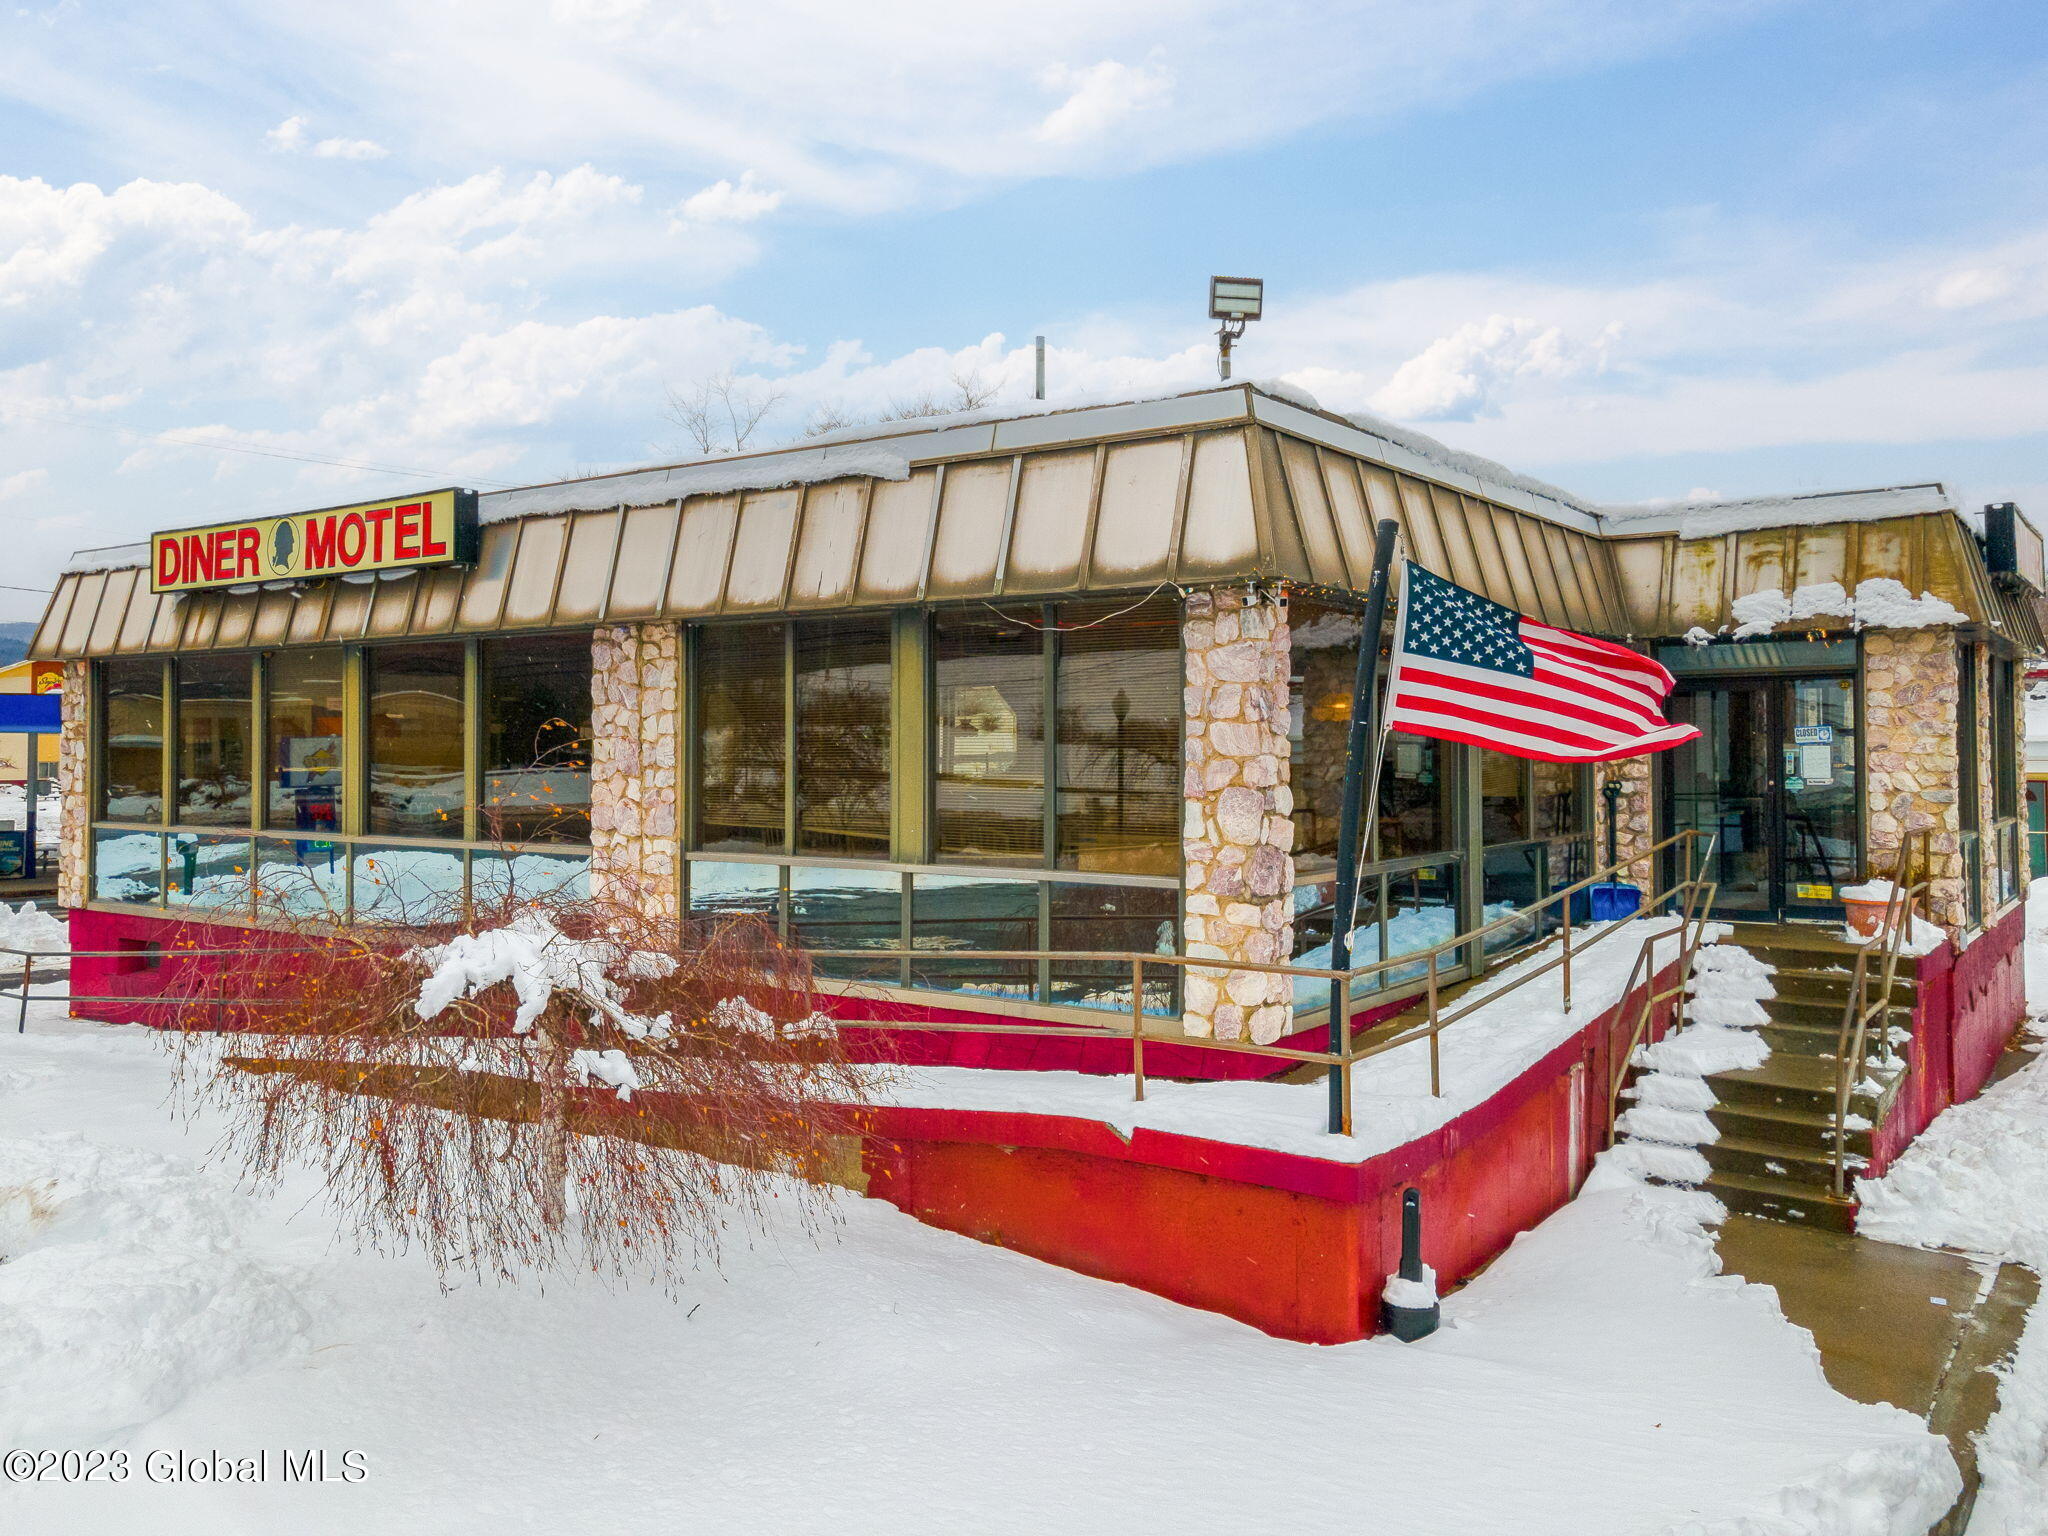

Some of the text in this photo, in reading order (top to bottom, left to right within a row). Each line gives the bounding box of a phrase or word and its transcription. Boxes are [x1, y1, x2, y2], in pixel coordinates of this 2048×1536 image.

[158, 501, 447, 587] DINER MOTEL
[1795, 728, 1818, 737] CLOSED
